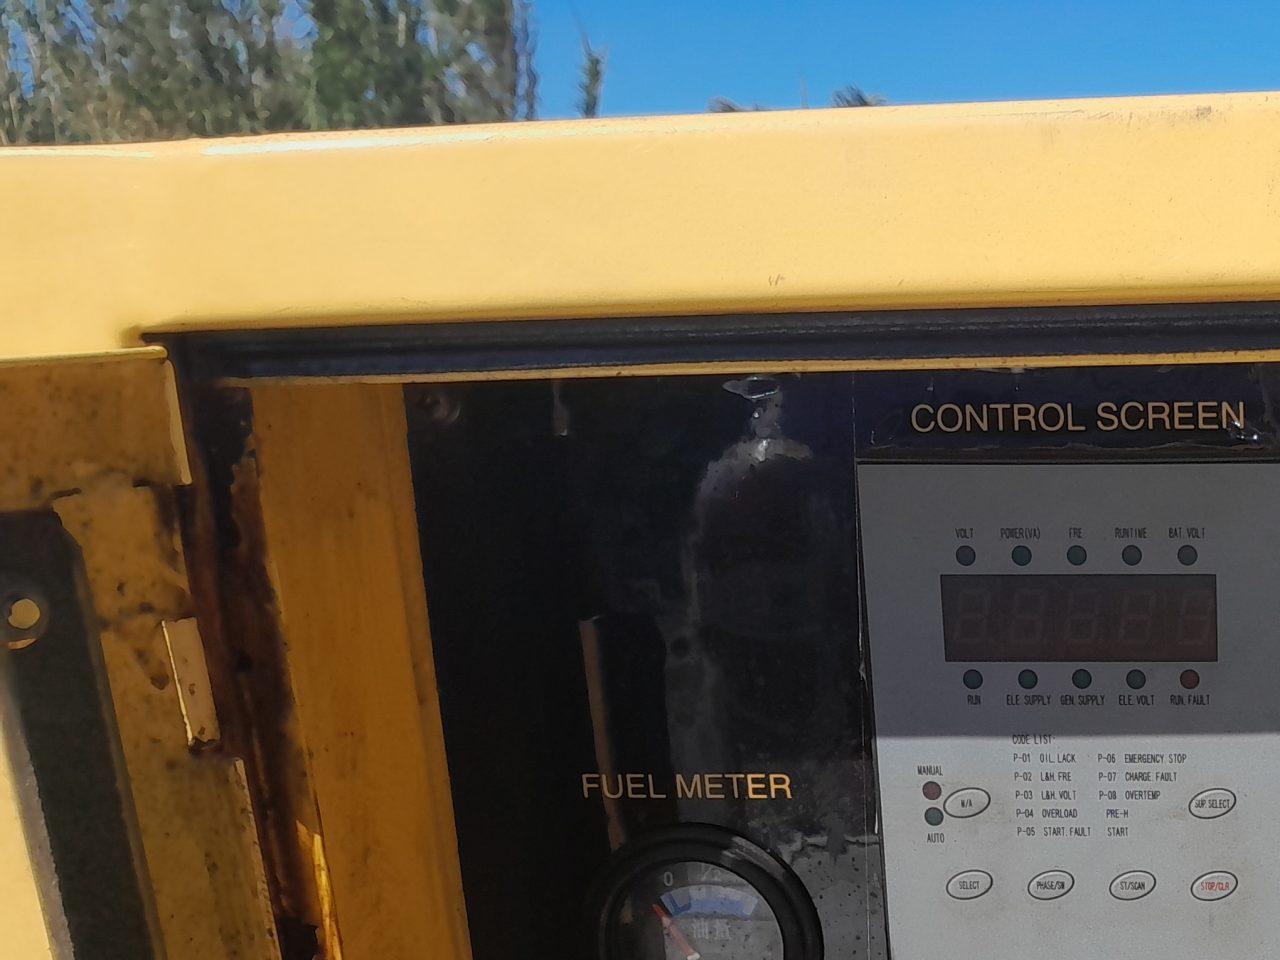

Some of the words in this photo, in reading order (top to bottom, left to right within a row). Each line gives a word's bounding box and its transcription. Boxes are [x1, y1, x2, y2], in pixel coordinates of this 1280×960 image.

[911, 401, 1086, 432] CONTROL
[1096, 400, 1245, 430] SCREEN
[954, 527, 974, 540] VOLT
[1068, 527, 1083, 539] FRE
[1114, 527, 1148, 539] RUNTIME
[1186, 527, 1205, 539] VOLT
[966, 694, 982, 706] RUN
[1023, 694, 1052, 706] SUPPLY
[1077, 694, 1105, 706] SUPPLY
[1136, 694, 1155, 706] VOLT
[1187, 694, 1210, 706] FAULT
[1012, 734, 1031, 745] CODE
[1013, 752, 1031, 763] P-01
[1057, 752, 1077, 764] LACK
[1097, 753, 1116, 764] P-06
[1124, 753, 1165, 764] EMERGENCY
[1168, 753, 1187, 764] STOP
[917, 765, 944, 777] MANUAL
[1013, 771, 1033, 782] P-02
[1057, 771, 1072, 782] FRE
[1098, 771, 1117, 782] P-07
[1155, 771, 1177, 782] FAULT
[581, 773, 667, 803] FUEL
[675, 773, 793, 799] METER
[1015, 789, 1033, 800] P-03
[1058, 790, 1077, 801] VOLT
[1098, 790, 1117, 801] P-08
[1124, 789, 1161, 801] OVERTEMP
[1207, 798, 1232, 810] SELECT
[1015, 808, 1034, 819] P-04
[1041, 808, 1078, 819] OVERLOAD
[1105, 808, 1129, 819] PRE-H
[1016, 826, 1036, 837] P-05
[1069, 826, 1091, 837] FAULT
[1107, 826, 1129, 837] START
[926, 832, 945, 844] AUTO
[958, 880, 980, 890] SELECT
[1119, 880, 1146, 891] ST/SCAN
